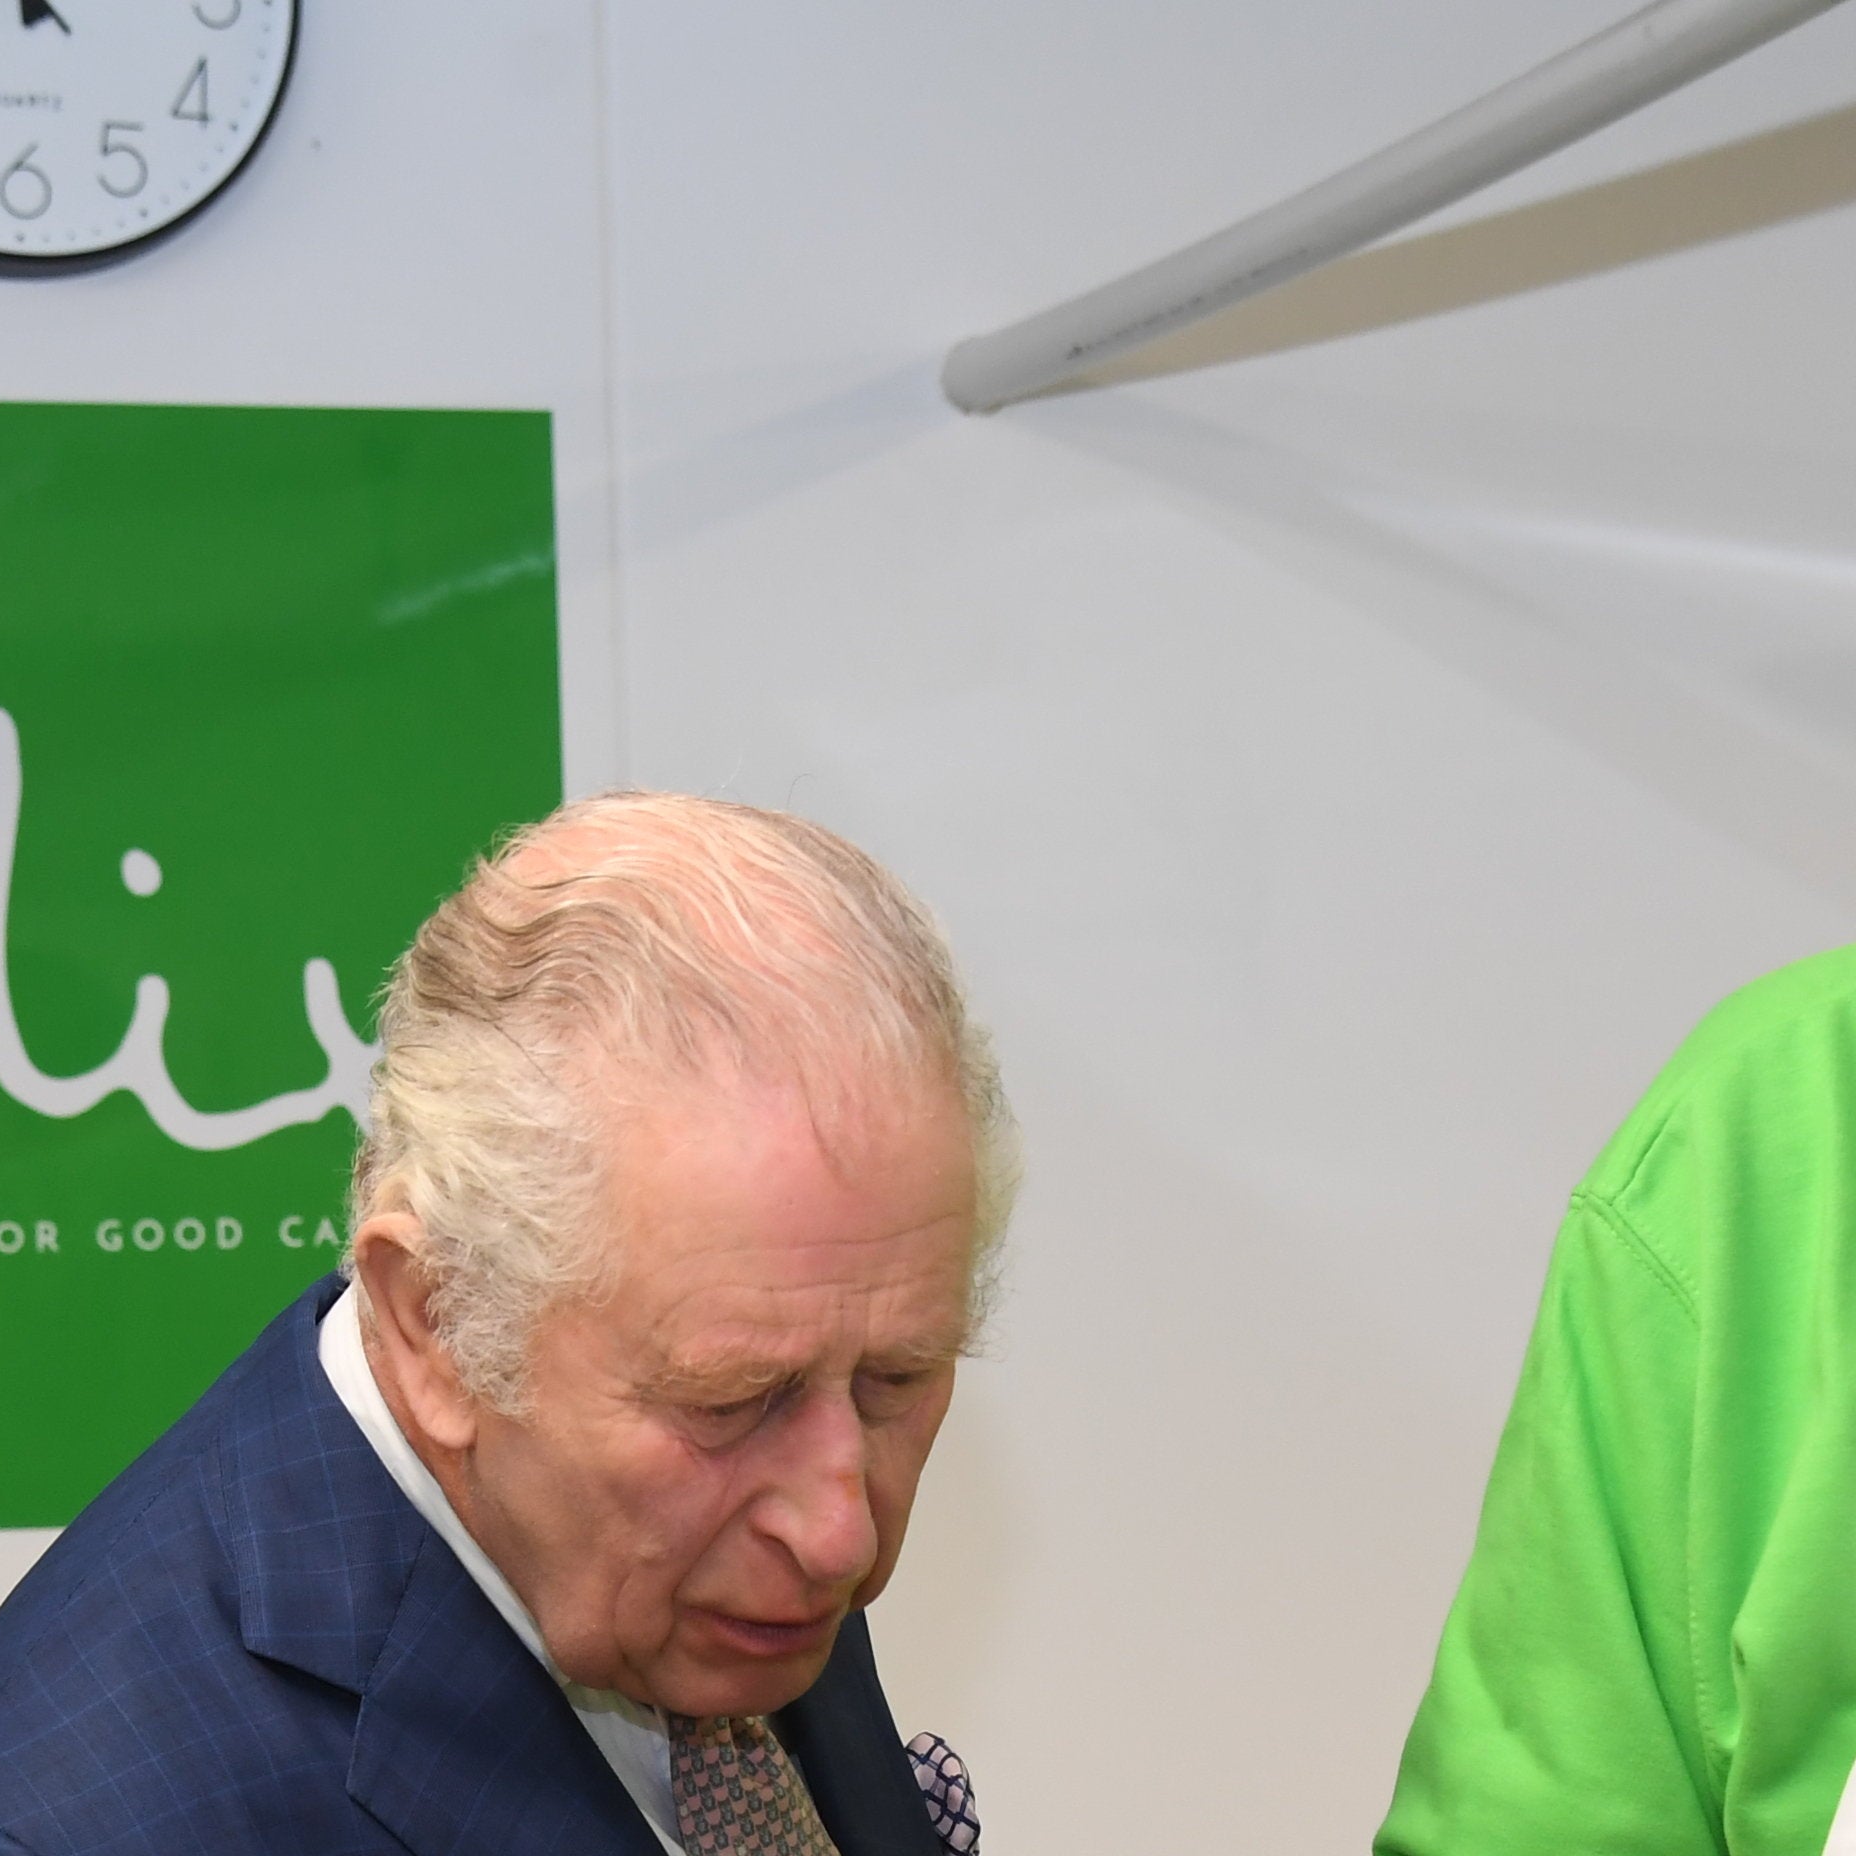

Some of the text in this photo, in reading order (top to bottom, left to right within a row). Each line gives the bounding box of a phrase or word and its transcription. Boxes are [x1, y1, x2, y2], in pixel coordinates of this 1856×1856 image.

[171, 56, 209, 126] 4
[97, 120, 149, 200] 5
[94, 1216, 245, 1253] GOOD
